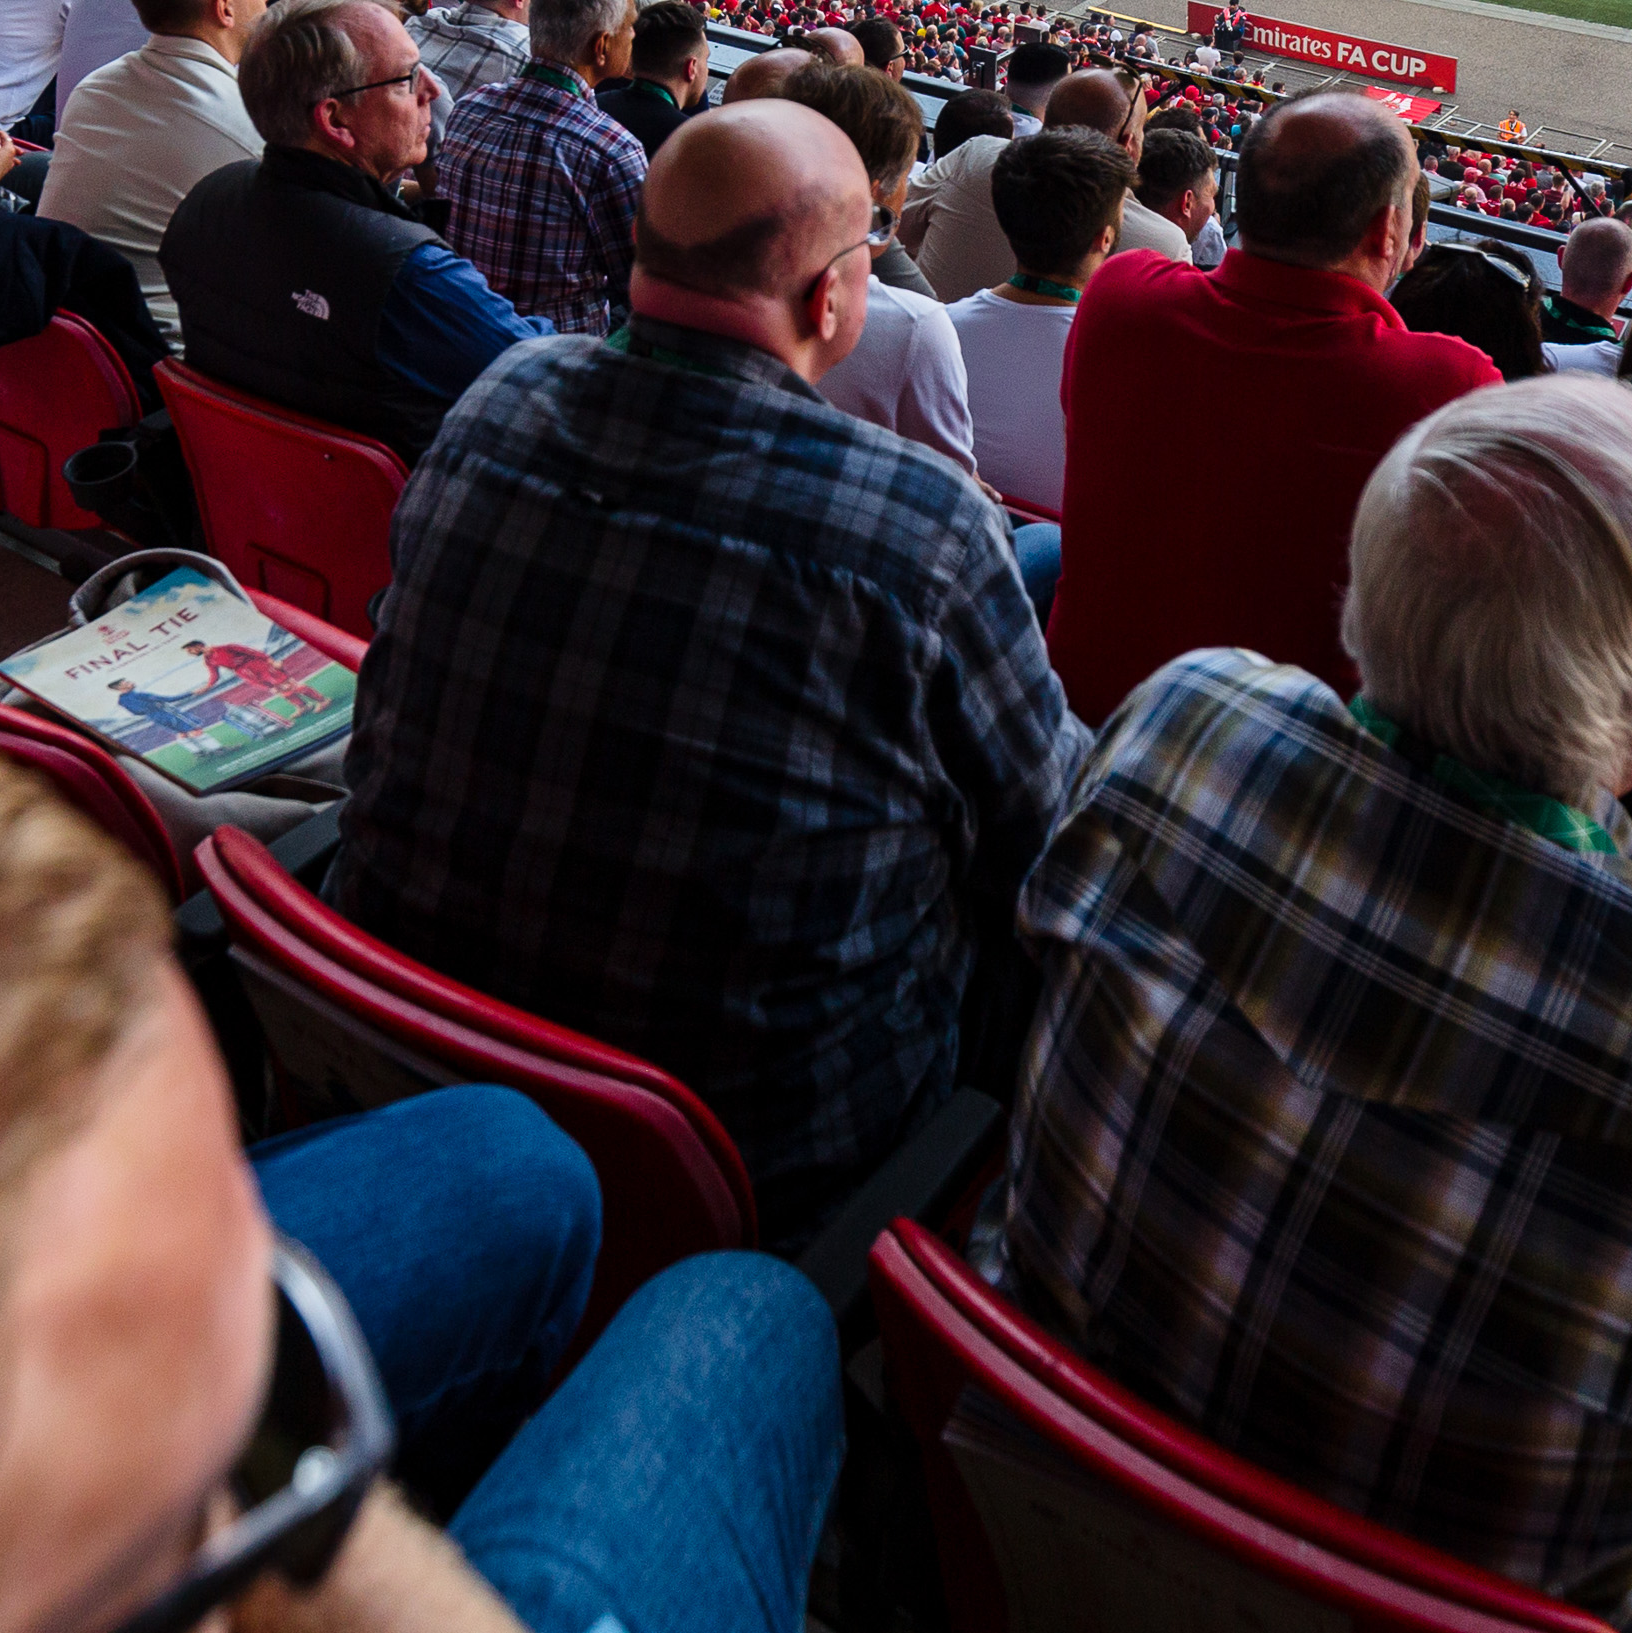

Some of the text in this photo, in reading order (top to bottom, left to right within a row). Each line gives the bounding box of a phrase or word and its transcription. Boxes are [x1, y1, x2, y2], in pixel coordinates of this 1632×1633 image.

[1243, 19, 1427, 78] Emirates FA CUP
[63, 640, 150, 681] FINAL
[149, 605, 200, 636] TIE
